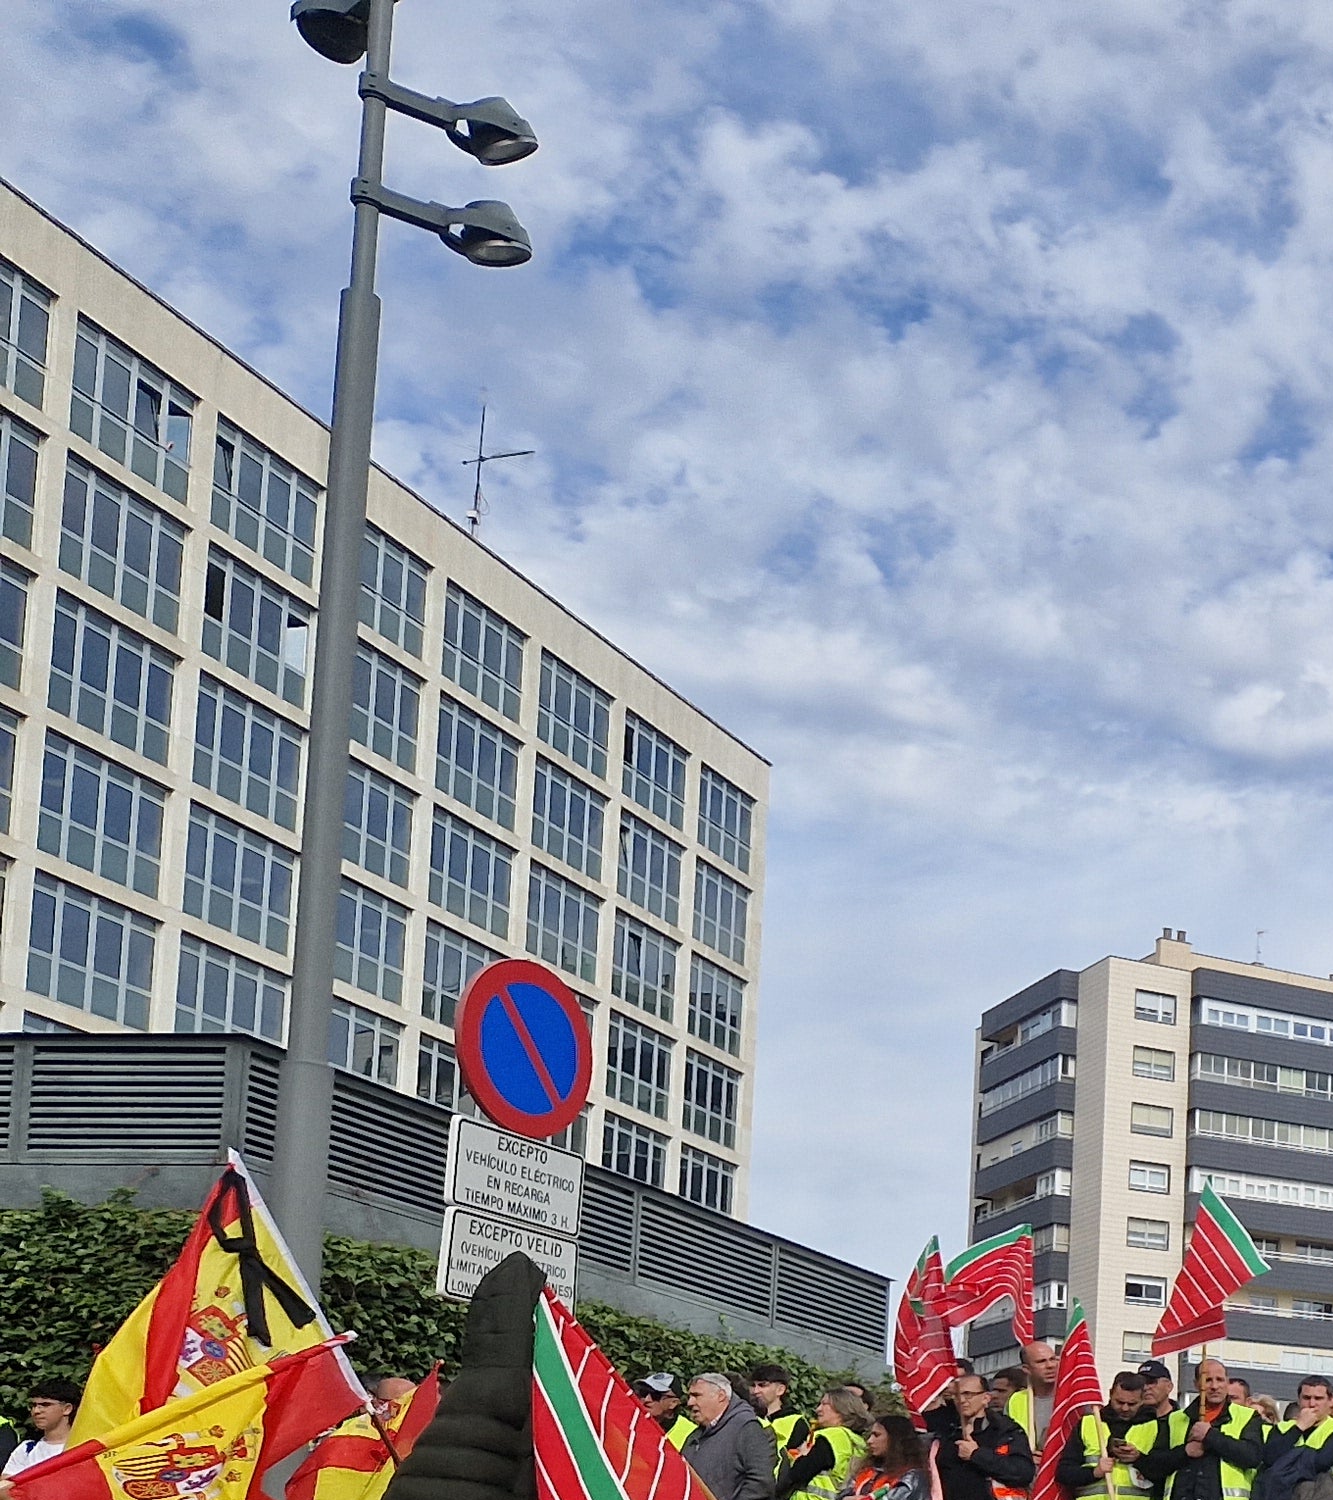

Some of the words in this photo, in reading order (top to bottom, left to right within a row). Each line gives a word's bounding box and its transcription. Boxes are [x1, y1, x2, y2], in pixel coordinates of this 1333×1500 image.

[498, 1136, 548, 1164] EXCEPTO
[466, 1149, 517, 1176] VEHÍCULO
[521, 1166, 575, 1193] ELÉCTRICO
[465, 1187, 504, 1211] TIEMPO
[507, 1198, 547, 1223] MÁXIMO
[551, 1213, 557, 1226] 3
[487, 1175, 500, 1191] EN
[504, 1180, 551, 1205] RECARGA
[469, 1219, 522, 1248] EXCEPTO
[527, 1236, 562, 1258] VELID
[450, 1257, 491, 1276] LIMITAD
